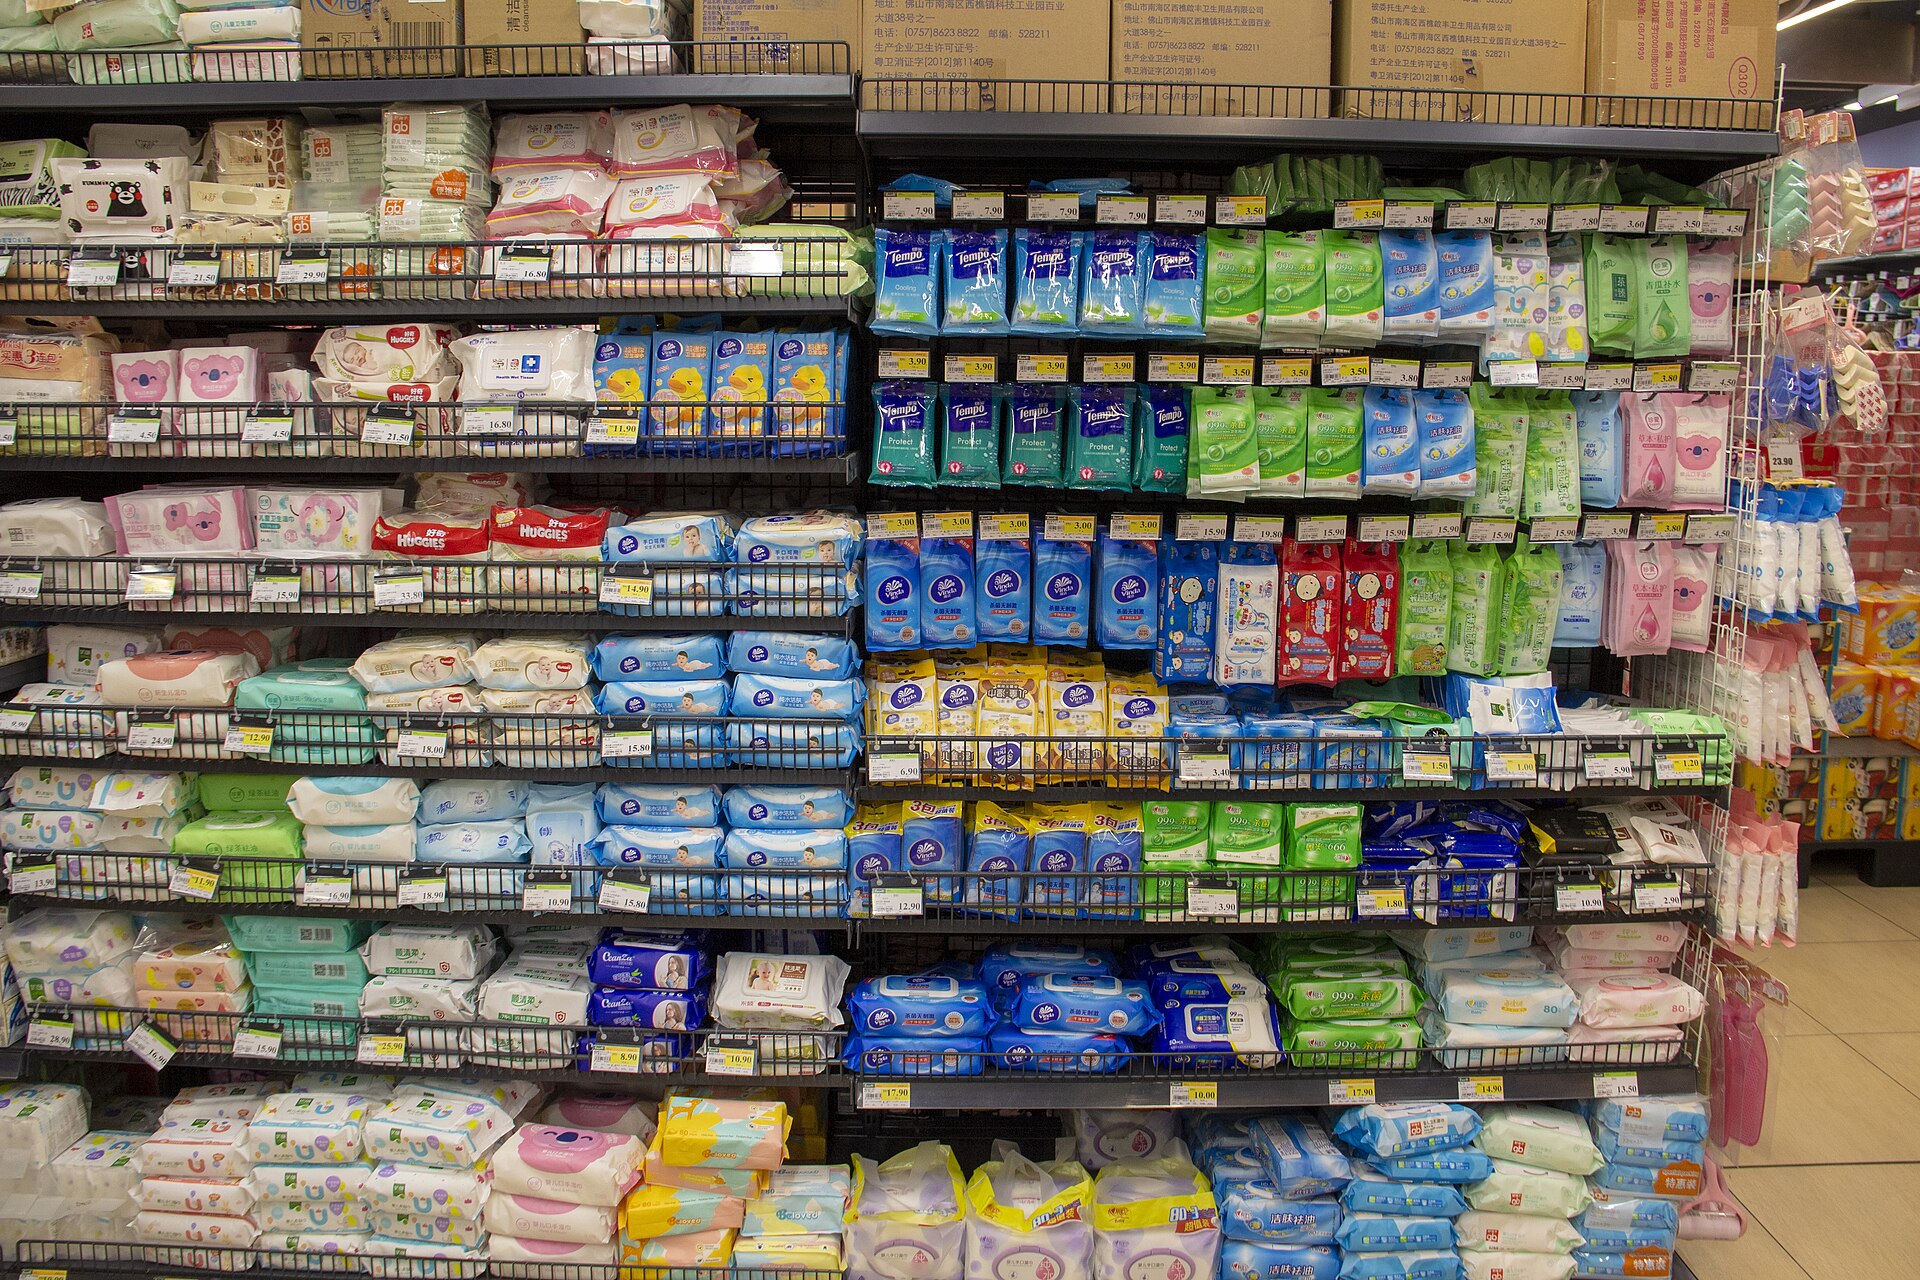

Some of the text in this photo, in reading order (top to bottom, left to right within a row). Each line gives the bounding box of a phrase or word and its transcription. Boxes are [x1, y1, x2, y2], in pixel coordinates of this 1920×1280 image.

[1738, 64, 1748, 96] Q302
[915, 206, 933, 216] 7.90
[984, 206, 1003, 216] 7.90
[1059, 207, 1078, 217] 7.90
[1186, 209, 1205, 219] 7.90
[1245, 207, 1264, 215] 3.50
[1364, 210, 1382, 219] 3.50
[1128, 211, 1147, 221] 7.90
[1415, 216, 1433, 224] 3.80
[1476, 217, 1494, 225] 3.80
[1529, 218, 1546, 226] 7.80
[1582, 218, 1598, 227] 7.80
[1627, 220, 1645, 229] 3.60
[1683, 220, 1701, 229] 3.50
[1726, 225, 1744, 234] 4.50
[888, 249, 924, 265] Tempo
[956, 249, 991, 266] Tempo
[1029, 250, 1064, 265] Tempo
[93, 272, 116, 284] 19.90
[192, 271, 216, 282] 21.50
[302, 270, 326, 281] 29.90
[523, 268, 547, 279] 16.80
[894, 283, 917, 293] Cooling
[390, 335, 416, 344] HUGGIES
[908, 357, 927, 367] 3.90
[974, 362, 993, 371] 3.90
[1047, 361, 1065, 371] 3.90
[1113, 361, 1132, 371] 3.90
[1233, 368, 1251, 377] 3.50
[1400, 374, 1418, 383] 3.80
[1562, 375, 1584, 384] 15.90
[1660, 374, 1678, 383] 3.80
[1719, 379, 1736, 387] 4.50
[489, 420, 512, 430] 16.80
[613, 424, 637, 433] 11.90
[139, 430, 157, 440] 4.50
[272, 430, 290, 439] 4.50
[386, 432, 410, 442] 21.50
[888, 437, 913, 446] Protect
[957, 437, 982, 446] Protect
[1021, 438, 1046, 448] Protect
[1089, 442, 1114, 452] Protect
[1159, 443, 1178, 452] Protect
[1772, 457, 1794, 466] 23.90
[897, 518, 915, 527] 3.00
[952, 517, 970, 527] 3.00
[1009, 519, 1027, 529] 3.00
[1074, 521, 1092, 530] 3.00
[519, 524, 569, 541] HUGGIES
[1204, 527, 1226, 537] 15.90
[1260, 529, 1283, 539] 19.80
[1713, 529, 1731, 538] 4.50
[397, 534, 446, 549] HUGGIES
[16, 585, 38, 595] 19.90
[625, 584, 650, 595] 14.90
[994, 581, 1013, 591] Vinda
[1054, 585, 1073, 595] Vinda
[401, 591, 423, 600] 33.80
[886, 587, 905, 597] Vinda
[937, 586, 957, 597] Vinda
[1121, 586, 1141, 596] Vinda
[11, 720, 28, 729] 9.90
[151, 736, 173, 746] 24.90
[249, 733, 271, 742] 12.90
[421, 744, 444, 755] 18.00
[627, 743, 651, 752] 15.80
[1431, 761, 1448, 770] 1.50
[1516, 763, 1534, 771] 1.00
[1683, 759, 1699, 767] 1.20
[900, 767, 918, 776] 6.90
[1212, 768, 1230, 777] 3.40
[1614, 766, 1631, 775] 5.90
[34, 879, 55, 888] 13.90
[193, 876, 215, 887] 11.90
[328, 891, 350, 901] 16.90
[423, 891, 444, 901] 18.90
[1663, 896, 1680, 905] 2.90
[548, 898, 570, 908] 10.90
[624, 898, 646, 909] 15.80
[898, 902, 921, 911] 12.90
[1386, 899, 1403, 908] 1.80
[1580, 899, 1602, 908] 10.90
[50, 1035, 71, 1045] 28.90
[382, 1041, 403, 1051] 25.90
[620, 1053, 638, 1062] 8.90
[729, 1055, 752, 1064] 10.90
[887, 1088, 908, 1097] 17.90
[1352, 1088, 1374, 1097] 17.90
[1481, 1084, 1503, 1093] 14.90
[1617, 1085, 1638, 1094] 13.50
[1194, 1091, 1216, 1100] 10.00
[702, 1149, 737, 1160] Beloved
[776, 1208, 818, 1221] Beloved
[667, 1216, 702, 1226] Beloved
